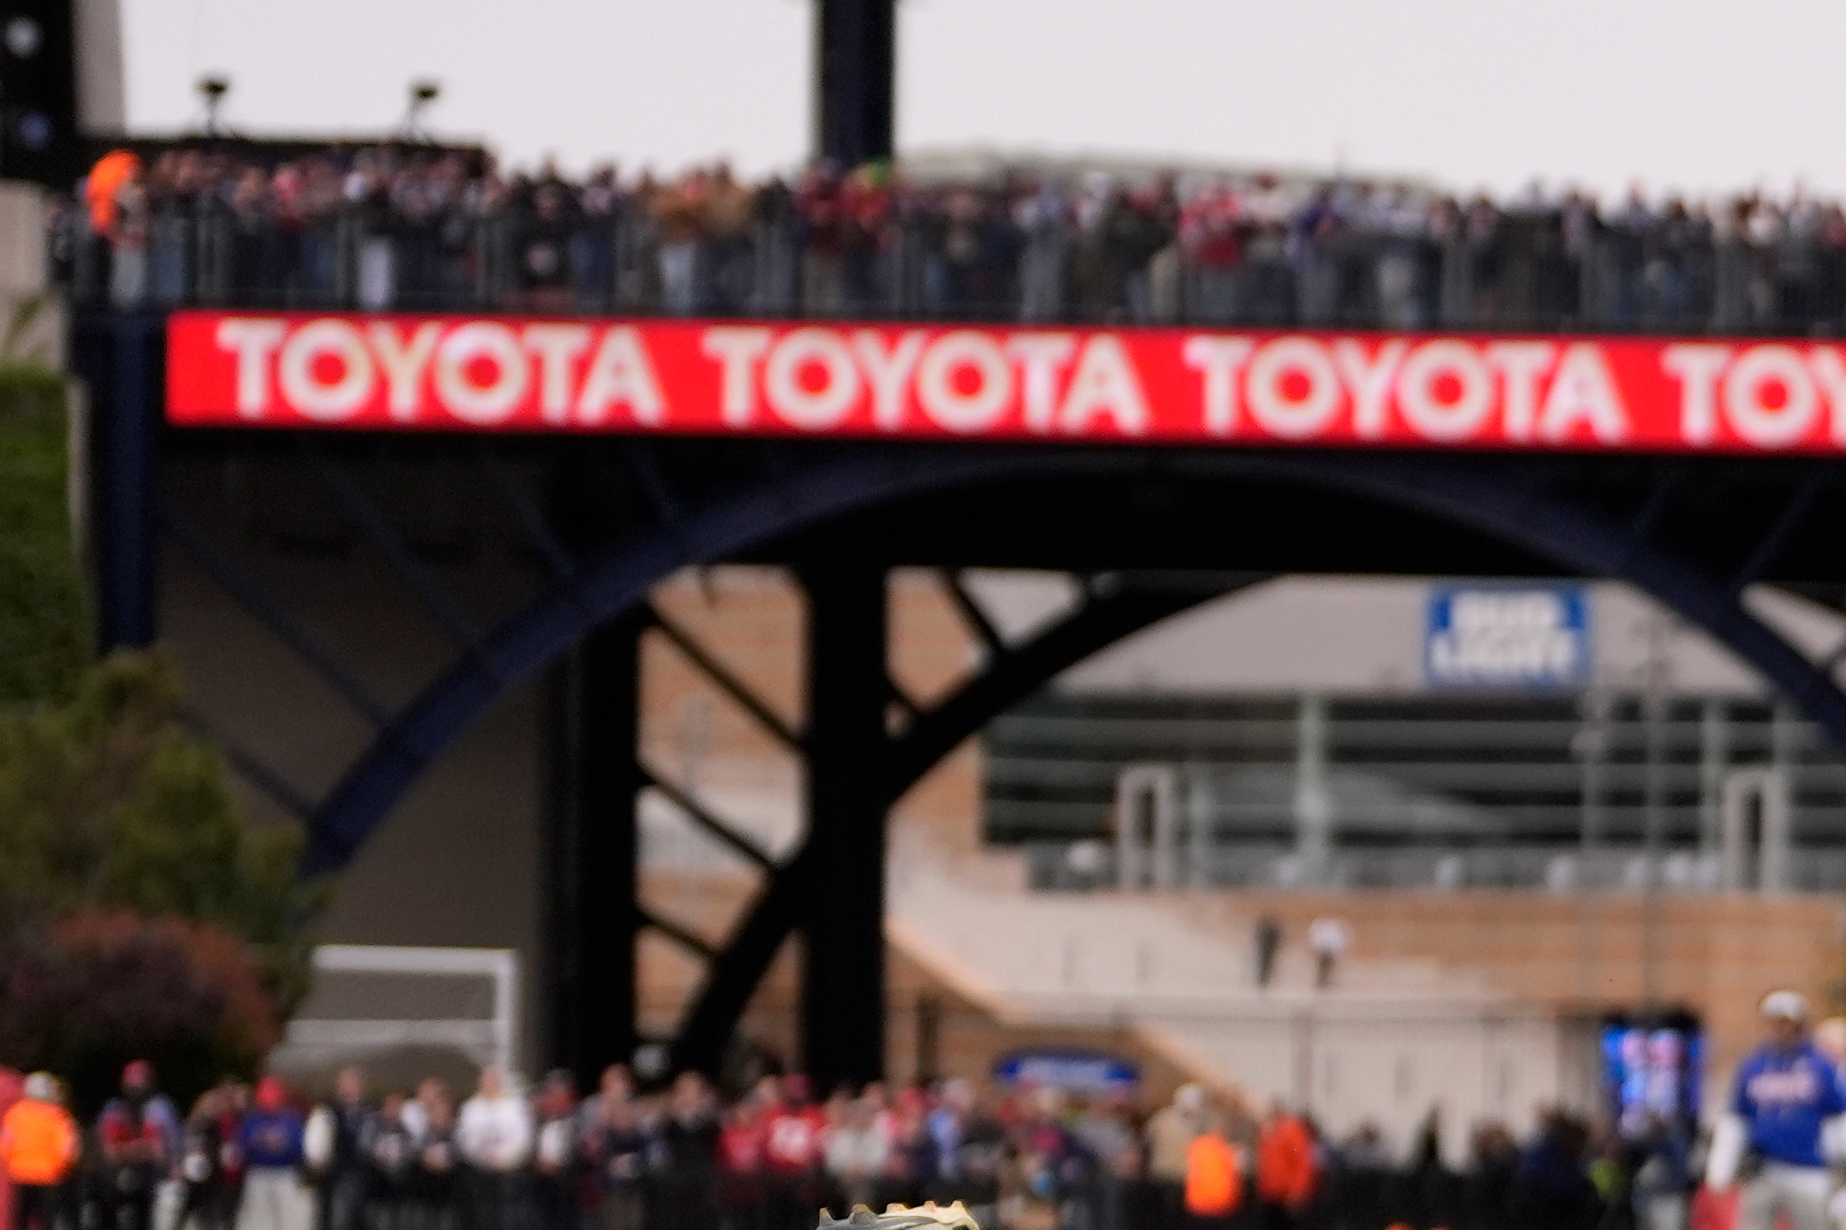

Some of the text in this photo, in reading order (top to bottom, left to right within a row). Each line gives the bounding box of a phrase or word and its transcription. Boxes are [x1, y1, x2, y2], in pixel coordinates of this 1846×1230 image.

[218, 317, 666, 427] TOYOTA
[703, 326, 1151, 437] TOYOTA
[1184, 334, 1627, 446] TOYOTA
